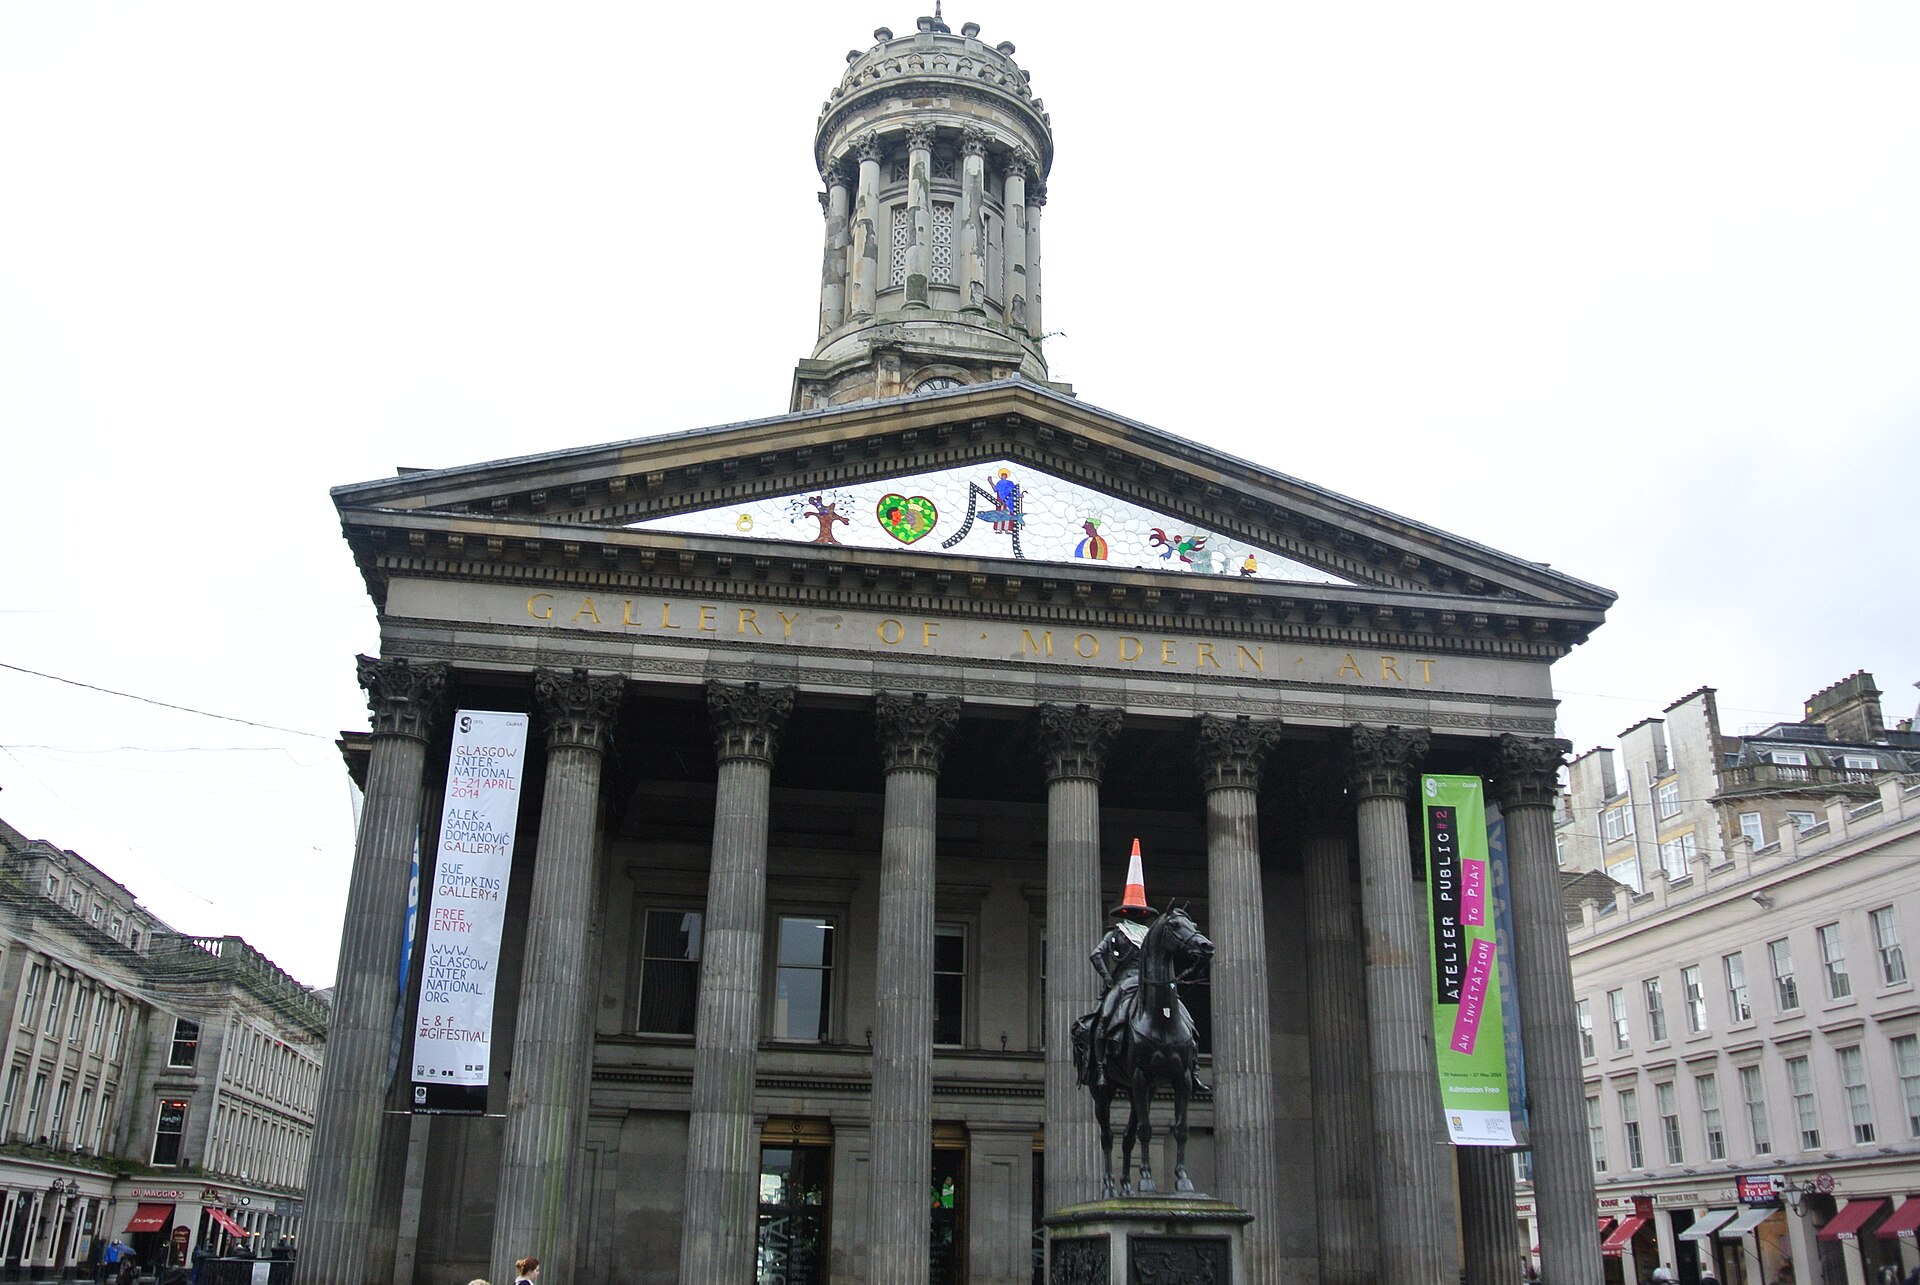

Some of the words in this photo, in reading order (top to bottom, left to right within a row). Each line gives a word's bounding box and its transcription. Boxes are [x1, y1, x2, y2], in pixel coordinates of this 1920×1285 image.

[527, 592, 799, 638] GALLERY
[876, 617, 940, 648] OF
[1020, 628, 1265, 672] MODERN
[1338, 653, 1438, 684] ART
[456, 745, 517, 758] GLASGOW
[455, 755, 499, 767] INTER-
[451, 787, 480, 799] 2014
[448, 808, 485, 820] ALEK-
[446, 819, 492, 832] SANDRA
[444, 841, 498, 854] GALLERY
[498, 846, 504, 856] 1
[441, 863, 464, 874] SUE
[440, 874, 500, 890] TOMPKINS
[1467, 864, 1479, 897] PLAY
[438, 886, 491, 899] GALLERY
[491, 891, 498, 901] 4
[435, 908, 465, 920] FREE
[433, 919, 473, 933] ENTRY
[429, 955, 488, 971] GLASGOW
[1442, 916, 1460, 999] ATELIER
[428, 967, 467, 980] INTER
[425, 991, 450, 1003] ORG
[434, 1015, 442, 1027] &
[447, 1016, 454, 1028] f
[1458, 1034, 1470, 1050] AN
[143, 1190, 184, 1199] MAGGIO'S
[1758, 1188, 1772, 1196] Let
